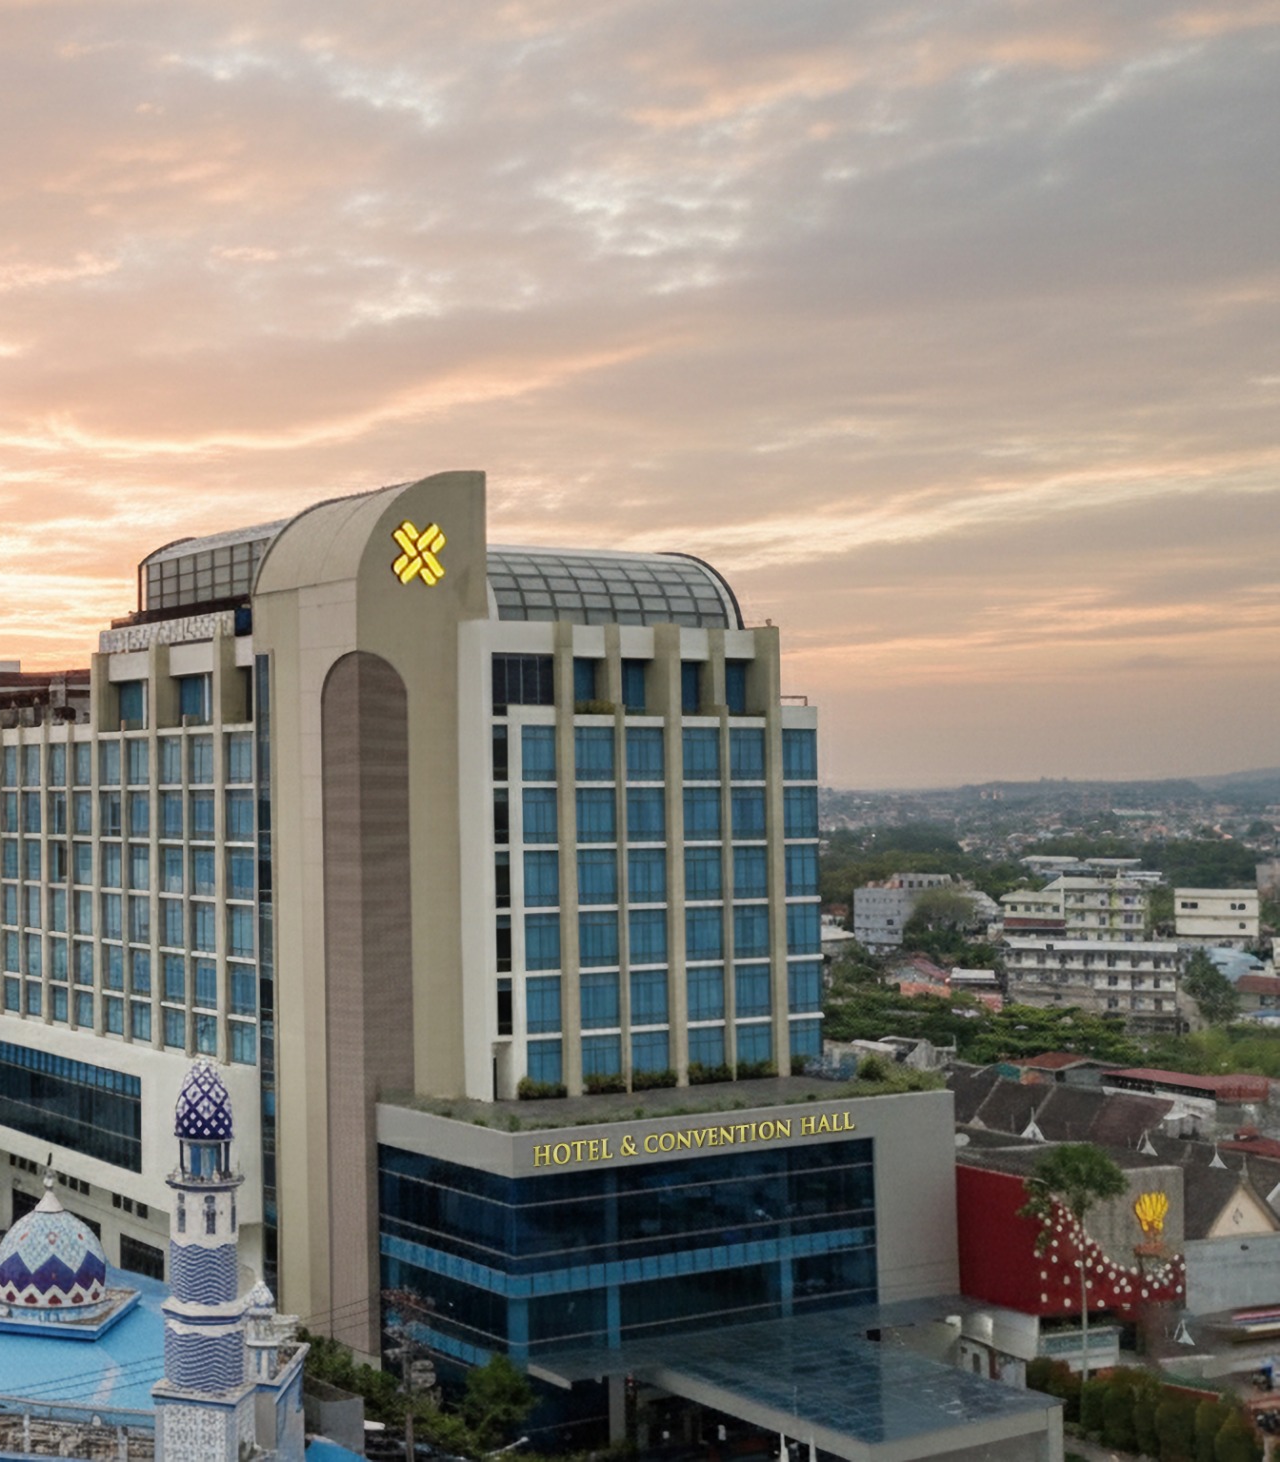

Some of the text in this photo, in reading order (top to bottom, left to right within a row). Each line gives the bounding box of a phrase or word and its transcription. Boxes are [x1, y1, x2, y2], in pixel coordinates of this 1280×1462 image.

[532, 1111, 856, 1167] HOTEL & CONVENTION HALL
